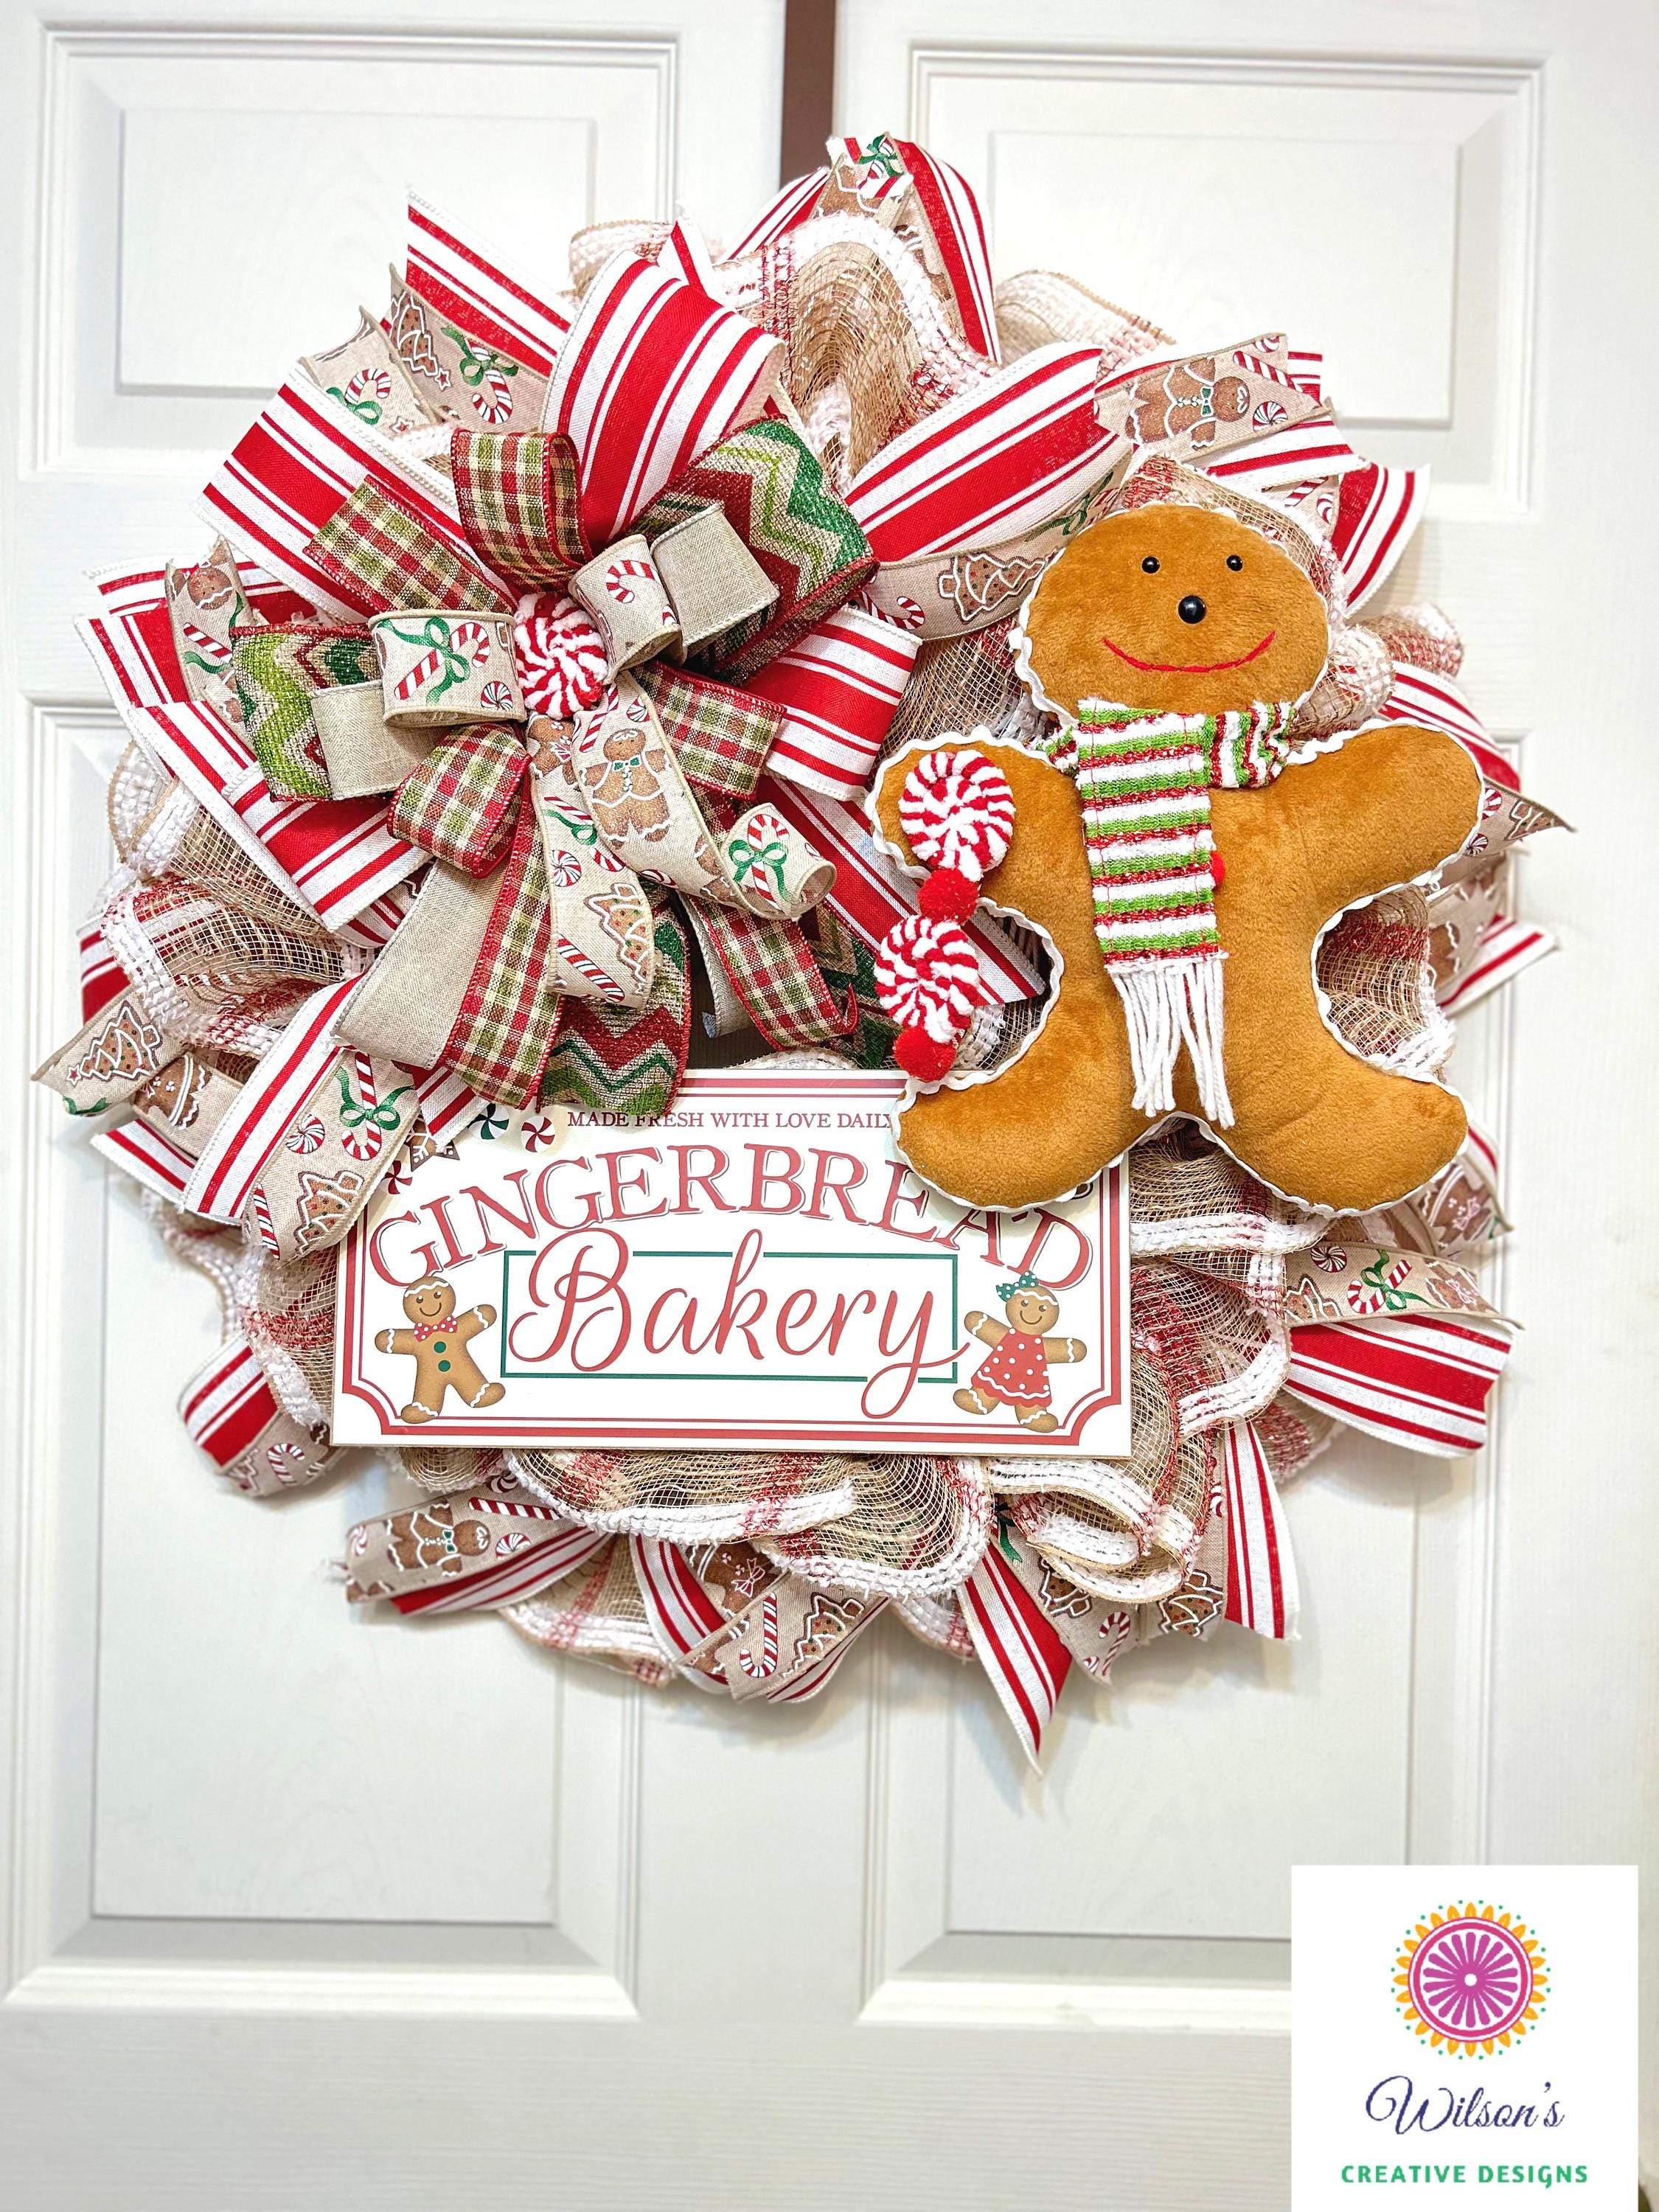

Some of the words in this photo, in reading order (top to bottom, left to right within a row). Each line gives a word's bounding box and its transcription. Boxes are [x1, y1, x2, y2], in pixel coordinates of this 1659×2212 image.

[567, 1112, 630, 1127] MADE
[635, 1112, 704, 1127] FRESH
[710, 1113, 769, 1128] WITH
[775, 1113, 832, 1128] LOVE
[369, 1143, 1093, 1291] GINGERBREAD
[508, 1227, 971, 1419] Bakery
